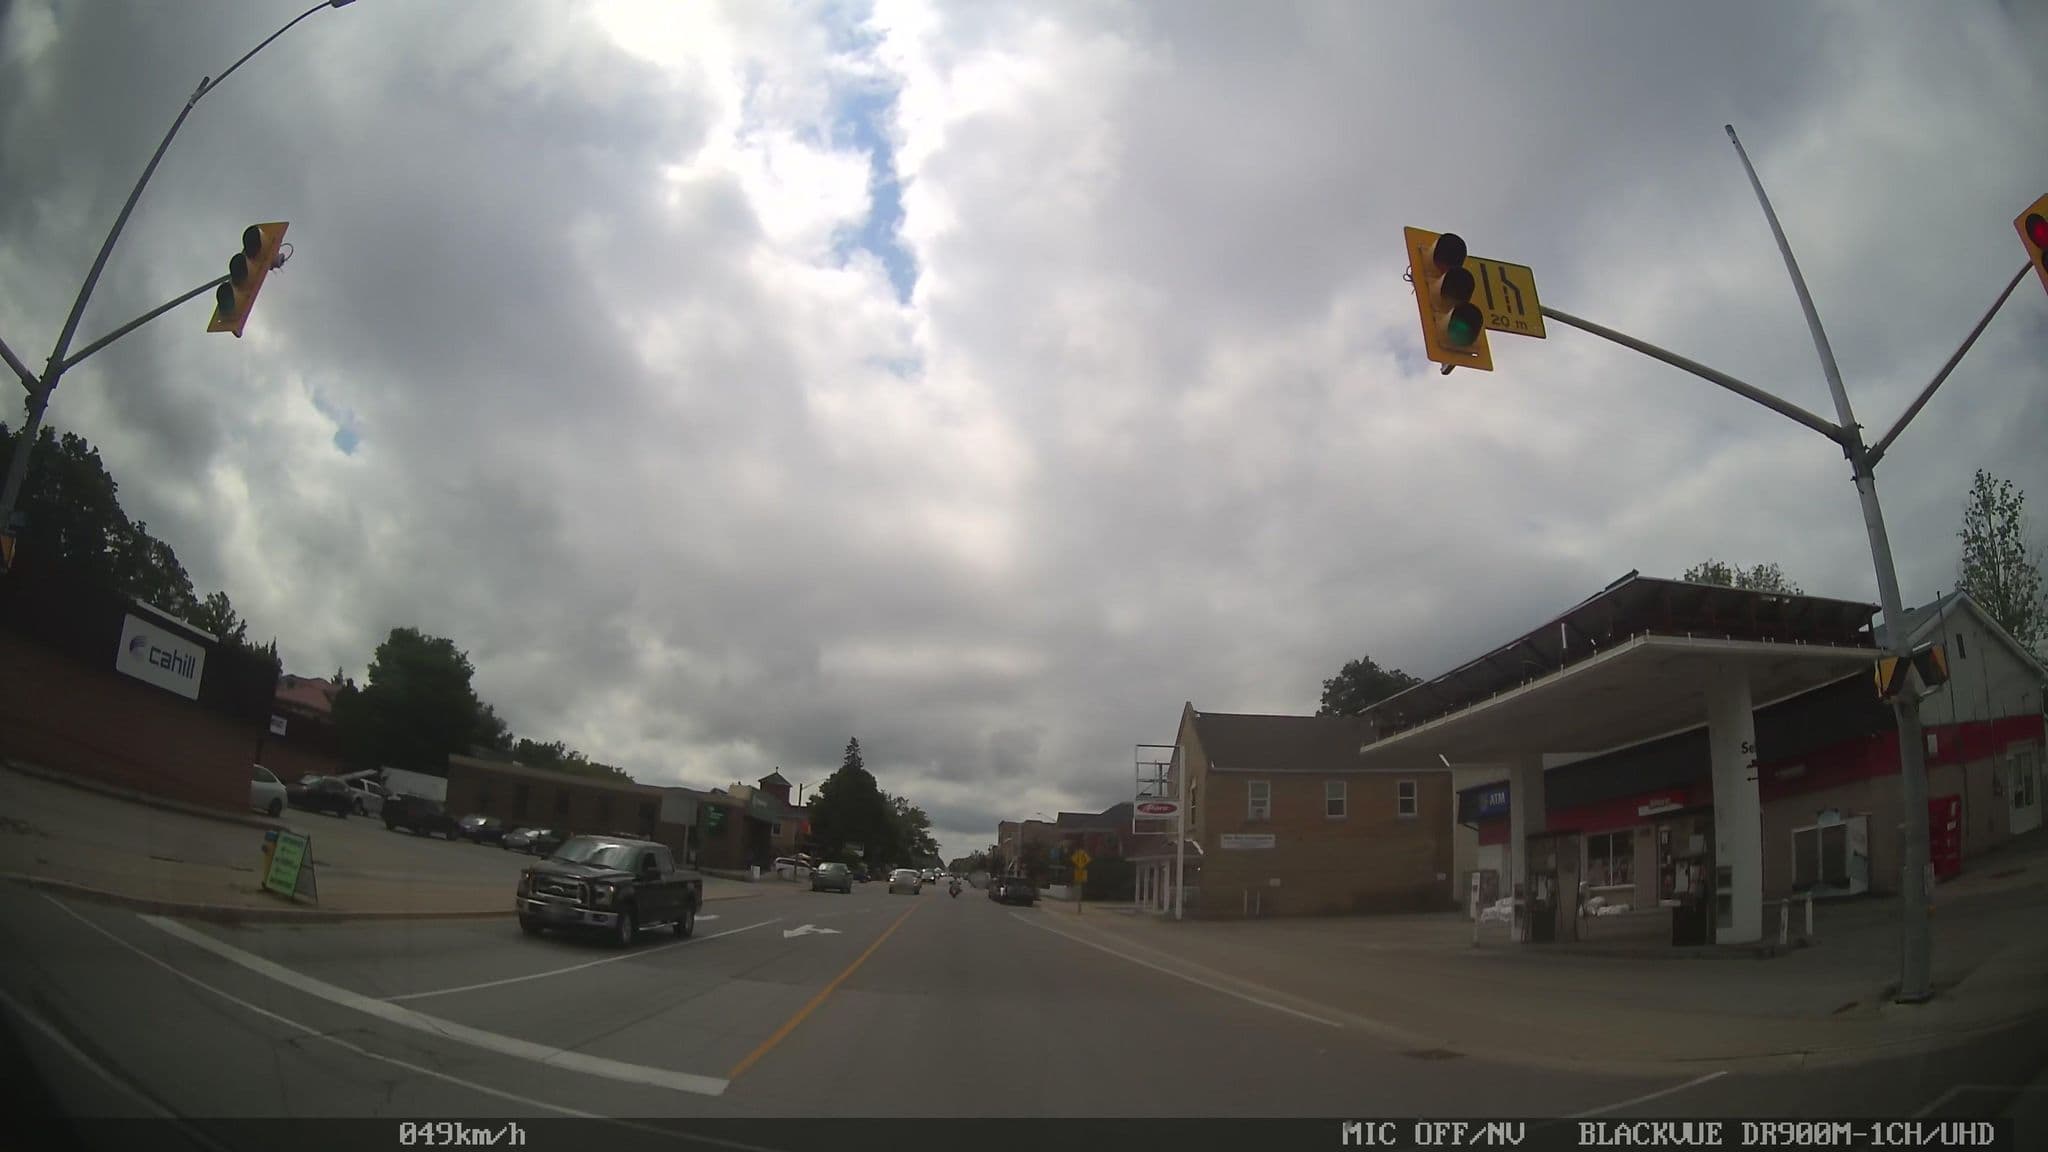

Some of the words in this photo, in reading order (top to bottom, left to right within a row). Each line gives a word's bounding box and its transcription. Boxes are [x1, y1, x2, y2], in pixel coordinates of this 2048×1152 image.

[1492, 315, 1510, 327] 20
[1516, 320, 1528, 330] m
[149, 645, 196, 680] cahill
[1489, 791, 1506, 807] ATM
